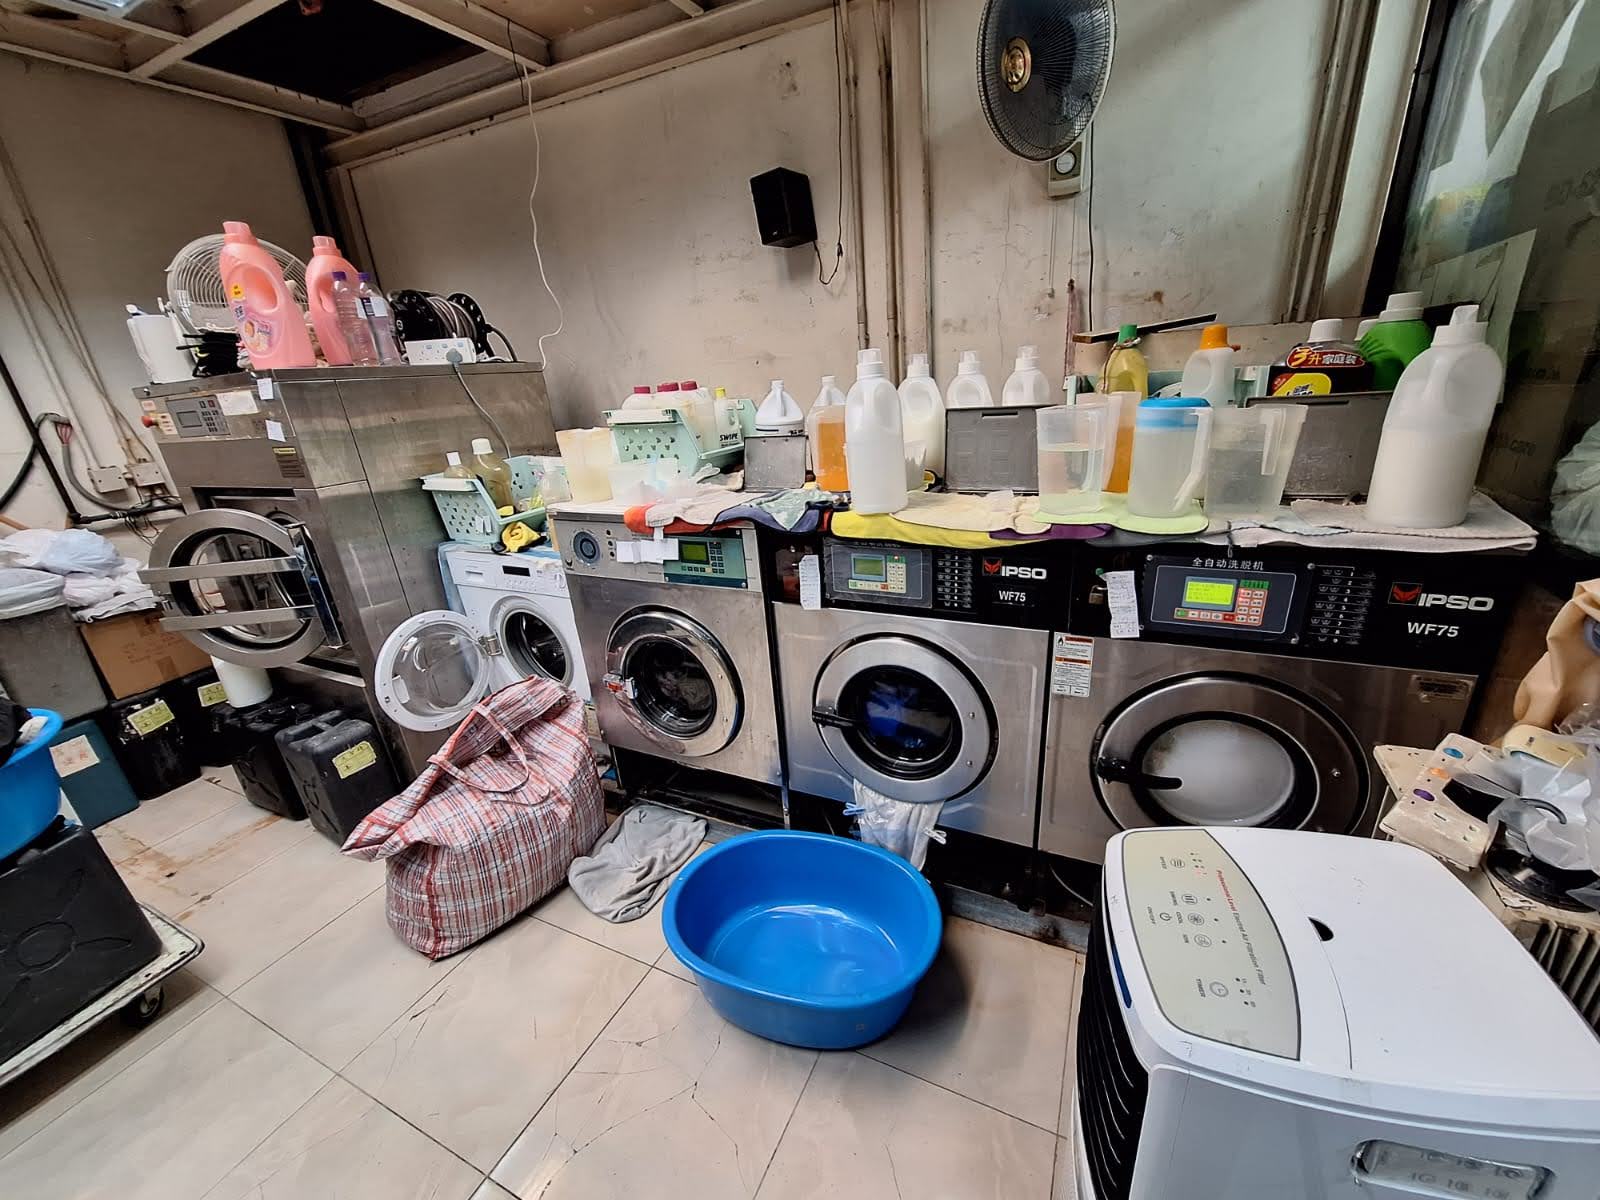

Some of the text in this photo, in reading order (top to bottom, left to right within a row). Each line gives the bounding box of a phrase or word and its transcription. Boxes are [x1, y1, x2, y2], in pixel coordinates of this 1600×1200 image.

[719, 433, 738, 441] SWIPE
[1192, 557, 1264, 571] 全自动洗脱机
[1001, 565, 1047, 580] IPSO
[998, 590, 1026, 602] WF75
[1418, 593, 1494, 611] IPSO
[1407, 621, 1459, 637] WF75
[1227, 897, 1238, 911] Level
[1195, 978, 1206, 998] TIMER
